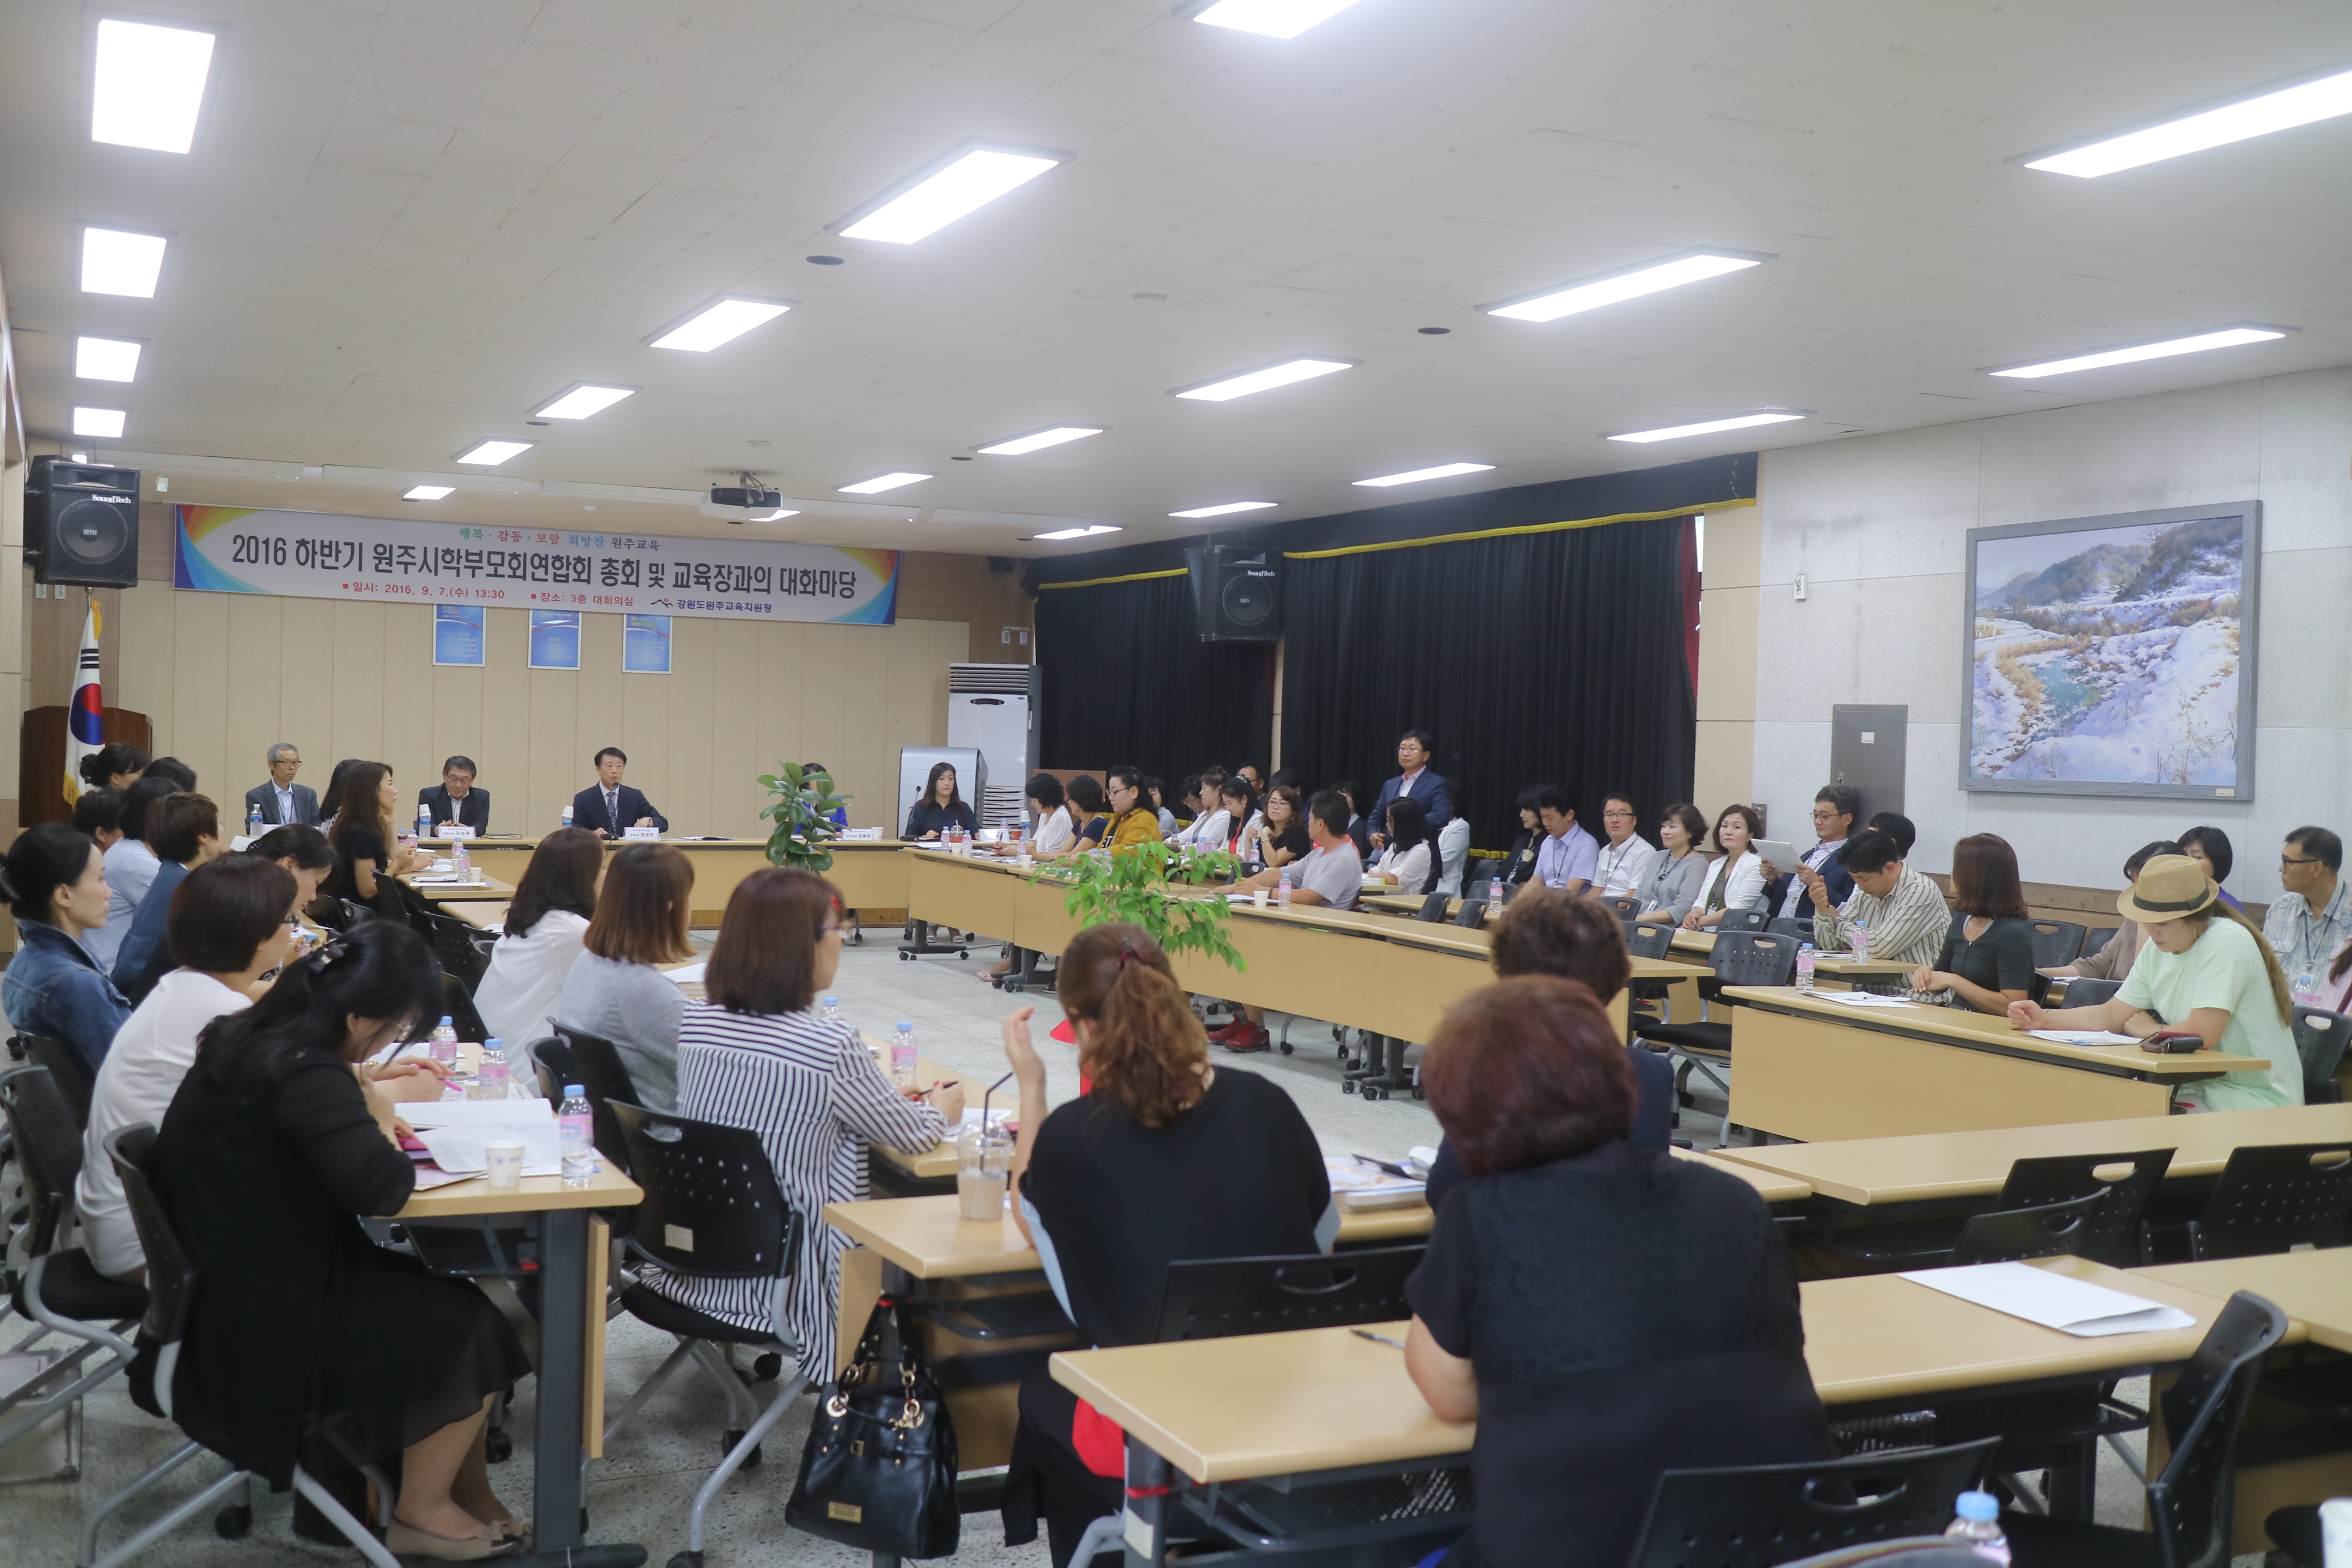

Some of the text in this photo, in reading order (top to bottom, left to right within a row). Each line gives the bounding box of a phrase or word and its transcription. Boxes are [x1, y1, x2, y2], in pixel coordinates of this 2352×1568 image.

[92, 494, 132, 504] SoundTech
[460, 528, 660, 552] 행복 감동 보람 희망찬 원주교육
[232, 534, 857, 599] 2016 하반기 원주시학부모회연합회 총회 및 교육장과의 대화마당
[353, 582, 505, 599] 일시: 2016. 9. 7.(수) 13:30
[541, 592, 633, 607] 장소: 3층 대회의실
[677, 599, 772, 614] 강원도원주교육지원청
